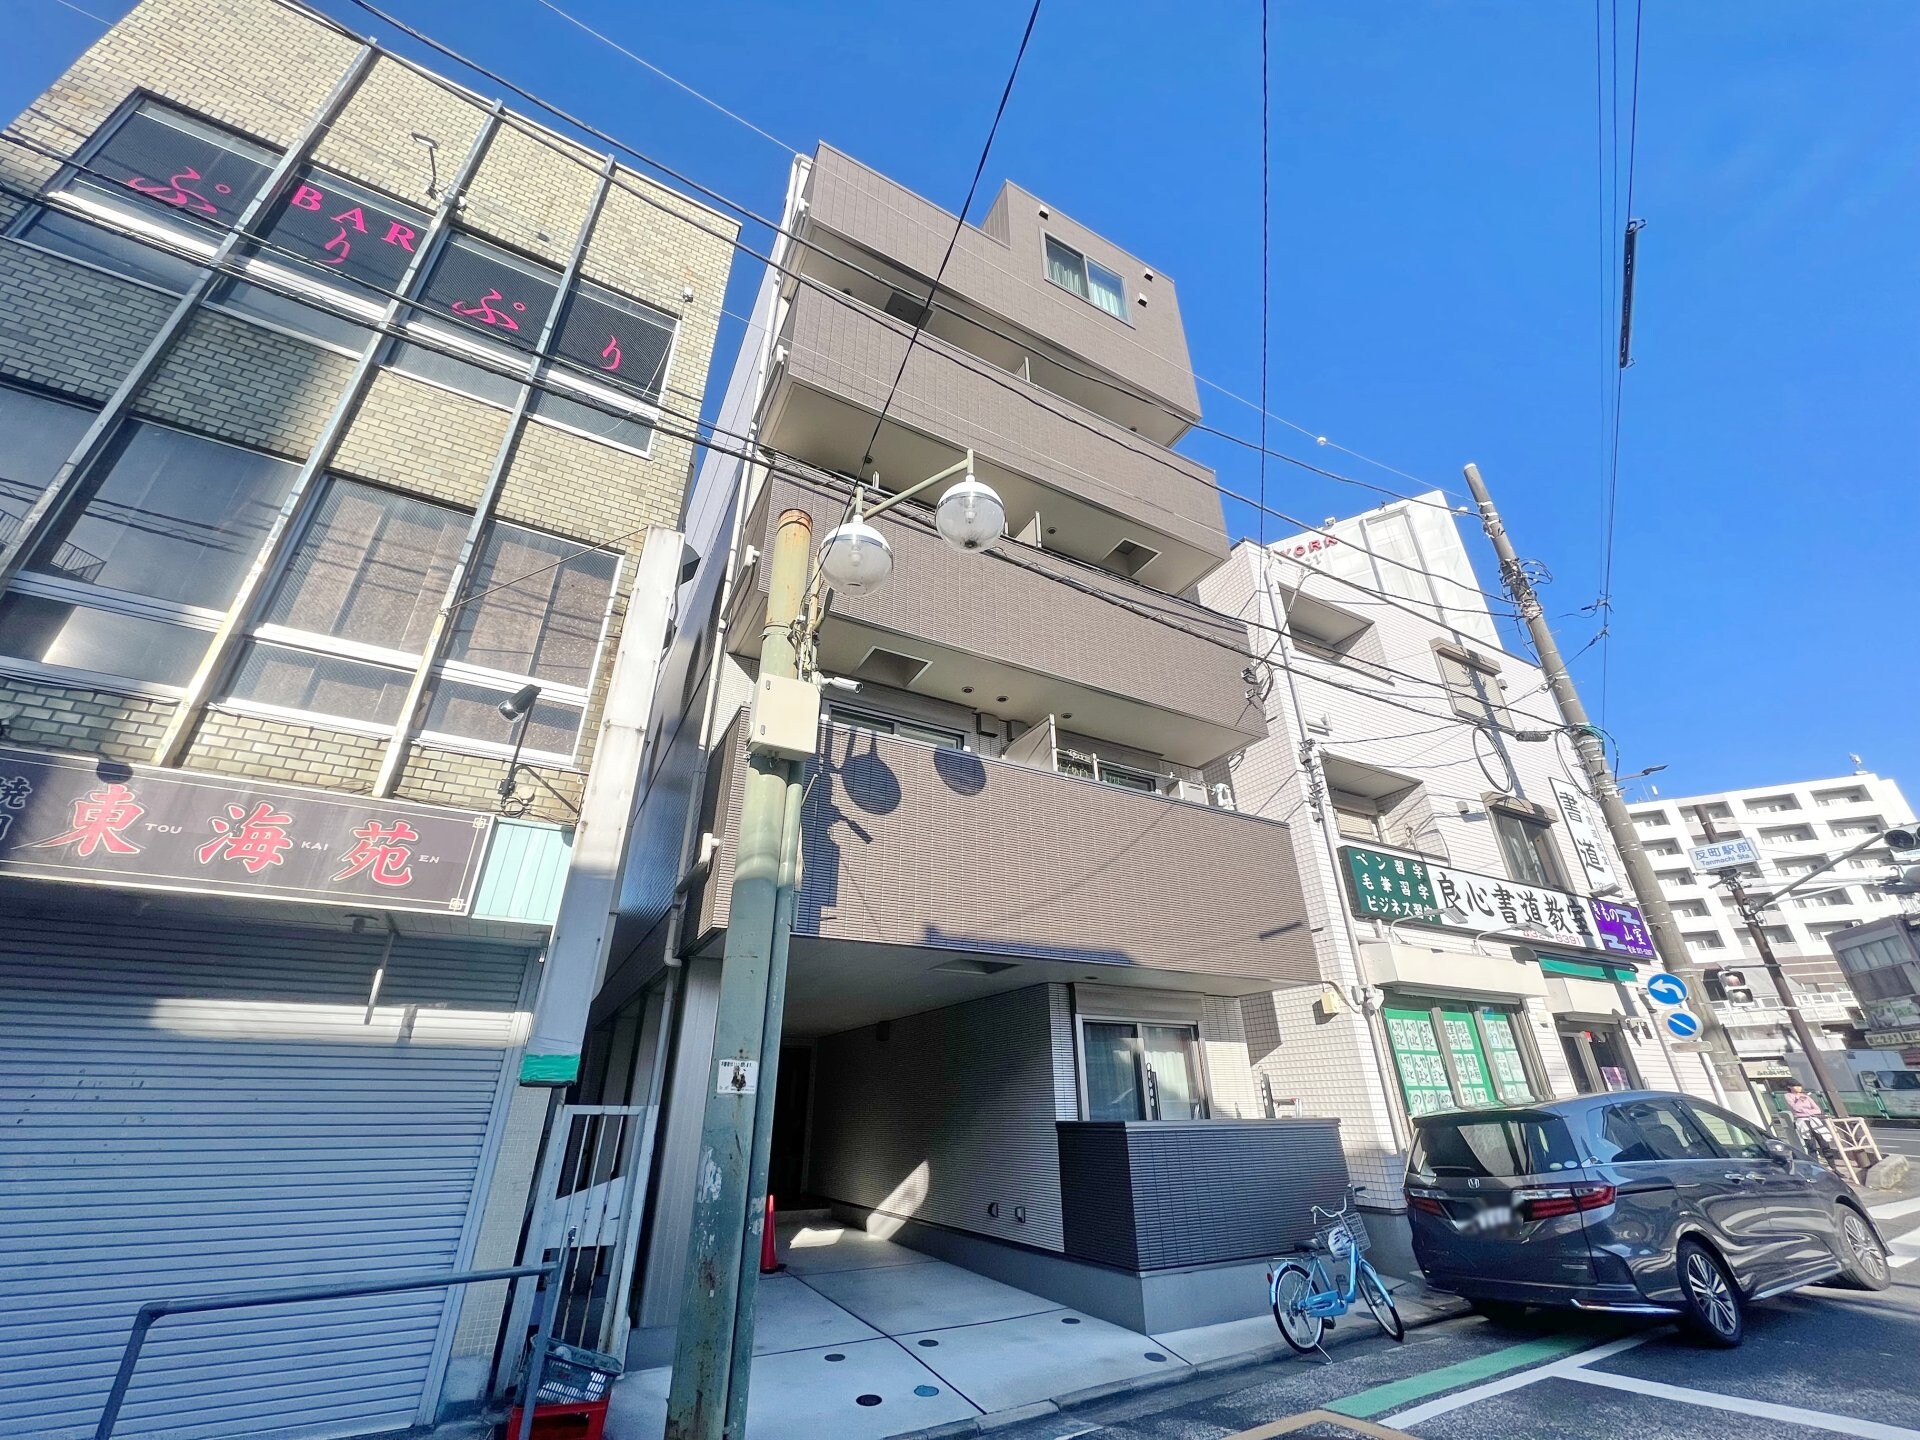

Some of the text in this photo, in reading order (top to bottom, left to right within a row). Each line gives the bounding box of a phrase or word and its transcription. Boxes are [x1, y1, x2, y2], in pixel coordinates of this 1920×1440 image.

[291, 185, 415, 252] BAR
[145, 822, 182, 835] TOU
[301, 841, 329, 852] KAI
[418, 855, 439, 865] EN
[1695, 842, 1751, 861] 反町駅前
[1356, 853, 1424, 880] ペン習字
[1701, 856, 1735, 866] Tanmachi
[1362, 872, 1430, 900] 毛筆習字
[1437, 871, 1594, 937] 良心書道教室
[1592, 901, 1620, 923] きもの
